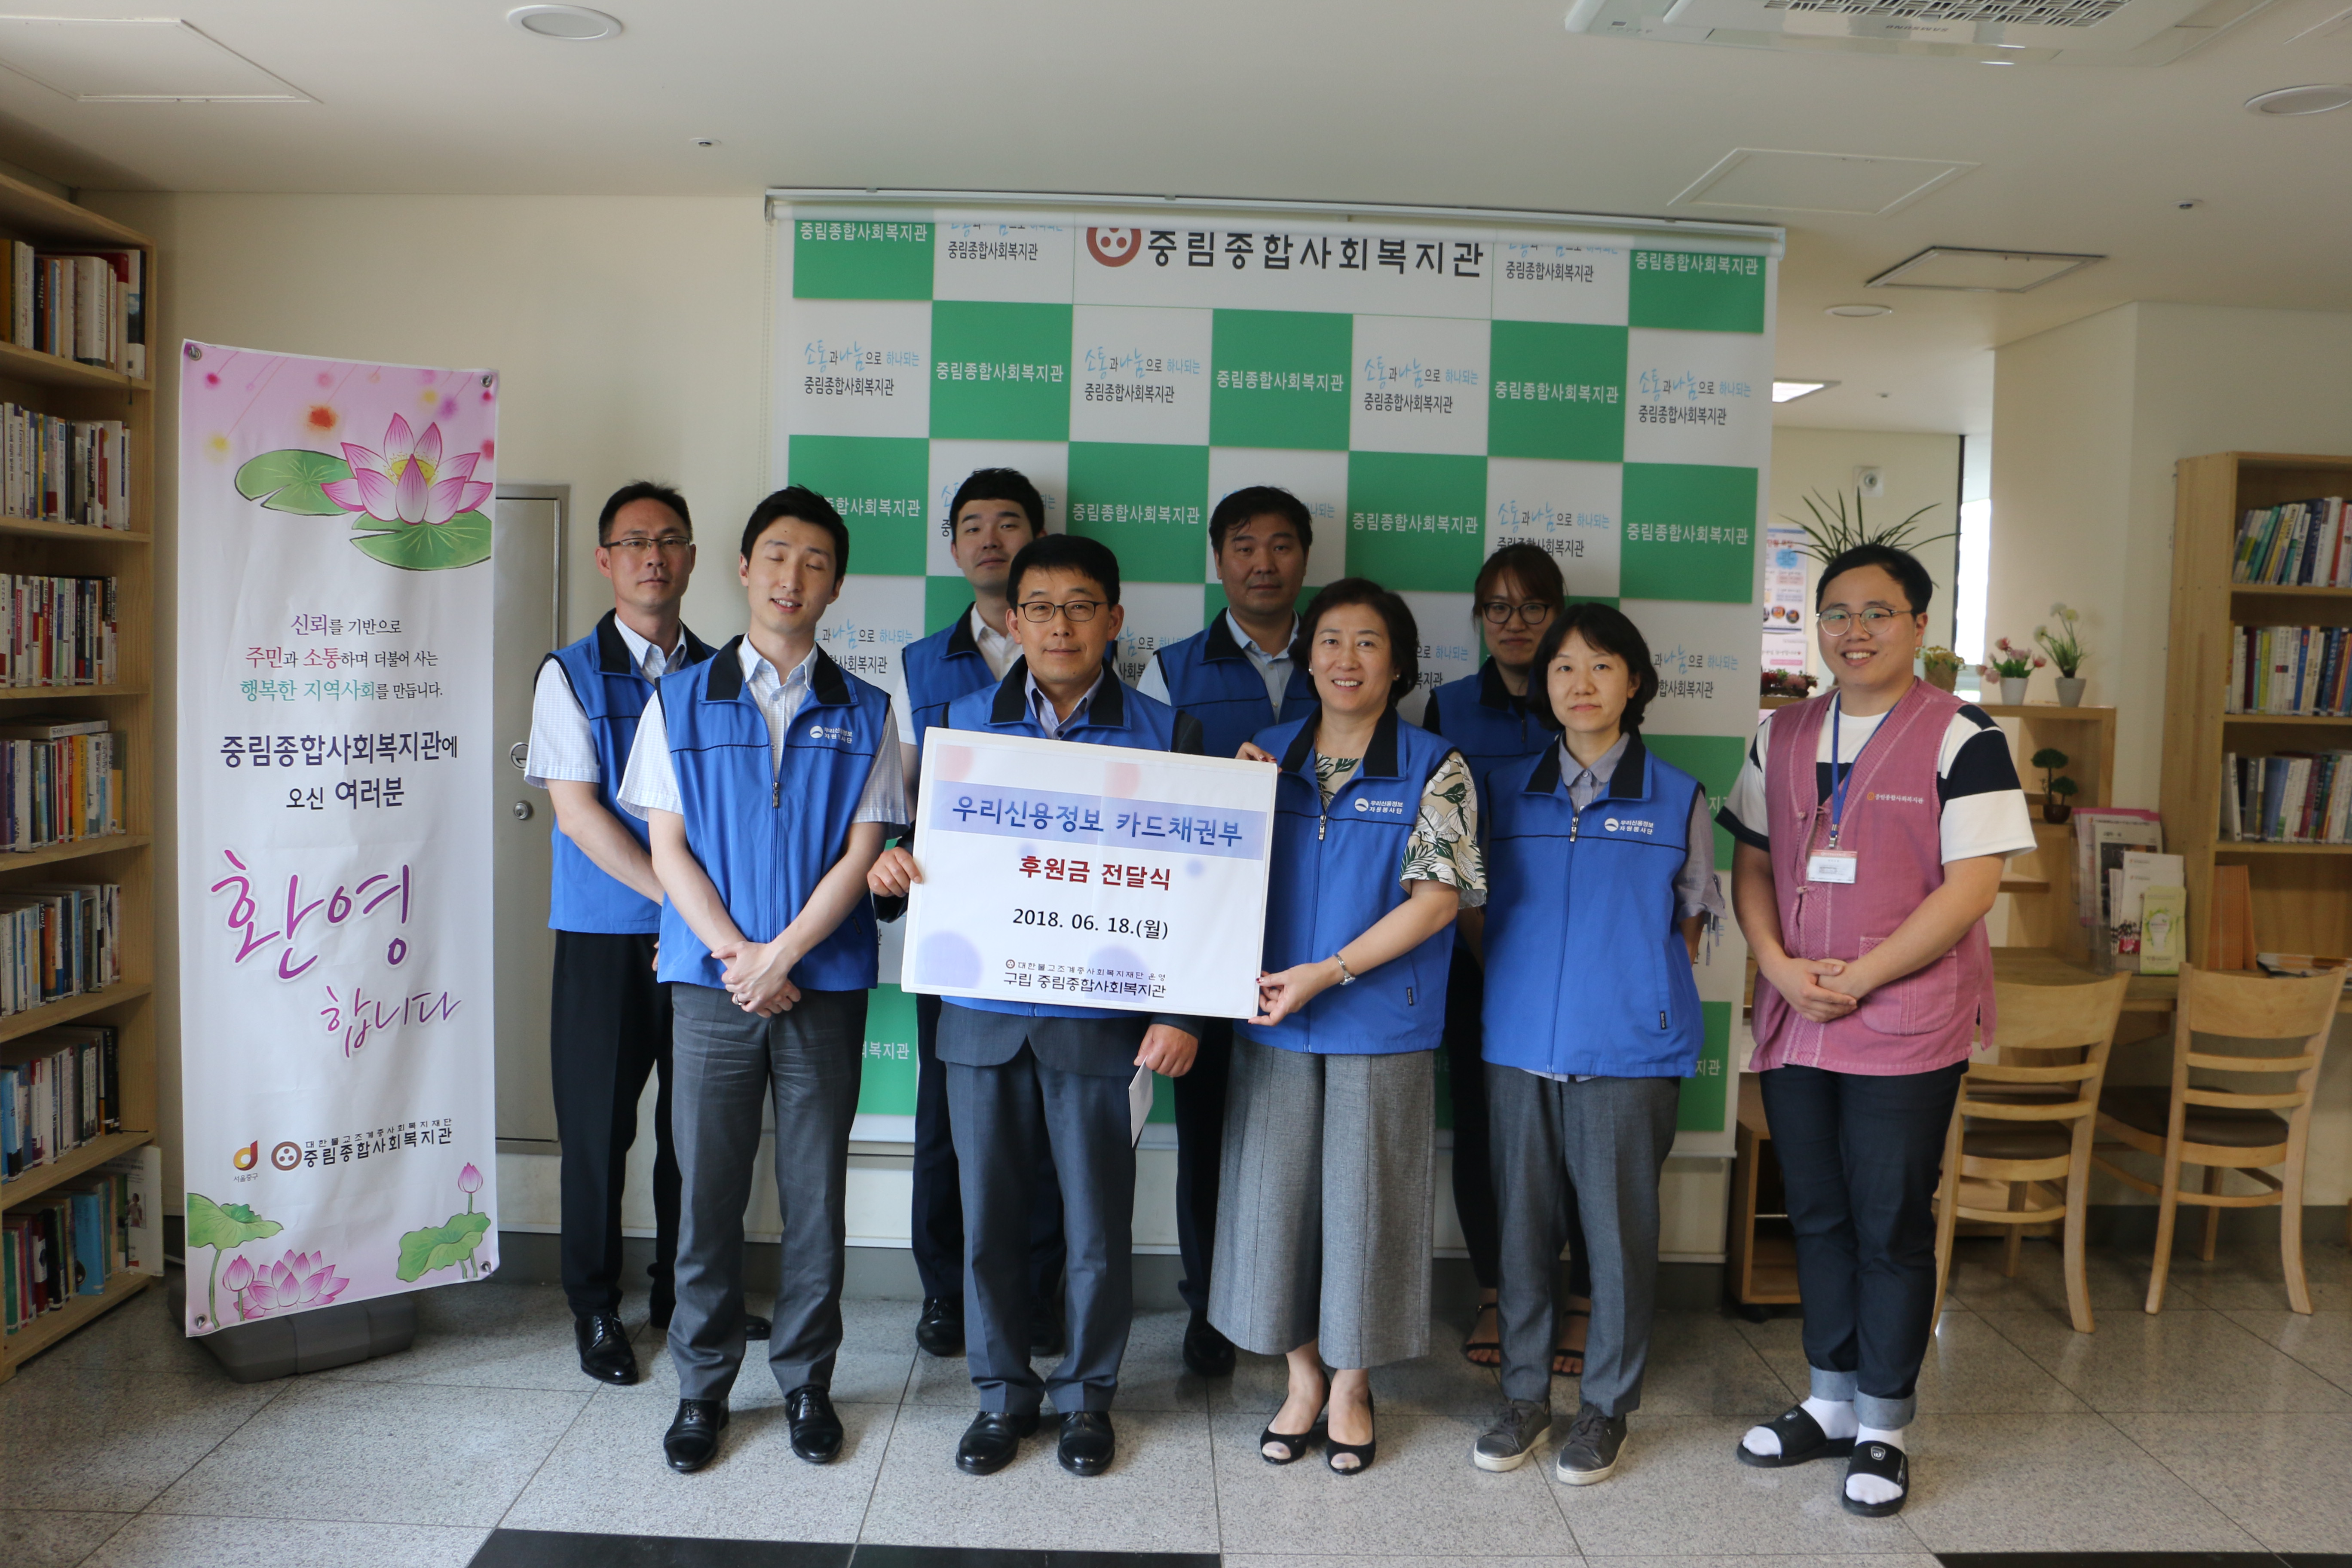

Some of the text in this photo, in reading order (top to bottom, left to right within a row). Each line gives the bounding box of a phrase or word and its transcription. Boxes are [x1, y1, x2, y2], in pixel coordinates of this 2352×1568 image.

[800, 222, 928, 242] 중림종합사회복지관
[948, 242, 1038, 260] 중림종합사회복지관
[1148, 230, 1483, 278] 중림종합사회복지관
[1506, 261, 1594, 282] 중림종합사회복지관
[1635, 252, 1758, 275] 중림종합사회복지관
[886, 352, 919, 367] 하나되는
[1167, 359, 1200, 375] 하나되는
[936, 362, 1063, 382] 중림종합사회복지관
[1216, 371, 1344, 392] 중림종합사회복지관
[1446, 369, 1478, 386] 하나되는
[804, 377, 894, 396] 중림종합사회복지관
[1085, 383, 1175, 404] 중림종합사회복지관
[1494, 381, 1618, 404] 중림종합사회복지관
[1719, 382, 1751, 398] 하나되는
[1364, 393, 1453, 414] 중림종합사회복지관
[1638, 406, 1727, 425] 중림종합사회복지관
[828, 497, 920, 517] 합사회복지관
[1072, 504, 1200, 524] 중림종합사회복지관
[1303, 502, 1335, 518] 나되는
[1352, 512, 1478, 534] 중림종합사회복지관
[1577, 513, 1609, 529] 하나되는
[1626, 523, 1749, 545] 중림종합사회복지관
[291, 613, 402, 637] 신뢰를 기반으로
[880, 629, 913, 644] 하나되는
[245, 646, 438, 670] 주민과 소통하며 더불어 사는
[1436, 645, 1468, 661] 하나되는
[1708, 655, 1738, 670] 하나되는
[830, 655, 887, 674] 사회복지관
[240, 679, 443, 701] 행복한 지역사회를 만듭니다.
[1659, 680, 1713, 698] 합사회복지관
[220, 730, 457, 769] 중림종합사회복지관에
[286, 777, 404, 810] 오신 여러분
[952, 796, 1243, 847] 우리신용정보 카드채권부
[1019, 855, 1171, 891] 후원금 전달식
[211, 849, 410, 980] 환영
[1012, 908, 1169, 940] 2018. 06. 18.(월)
[1018, 962, 1144, 980] 대한불교조계종사회복지재단
[1004, 972, 1166, 998] 구립 중림종합사회복지관
[321, 985, 462, 1058] 합니다
[305, 1118, 452, 1149] 대한불교조계종사회복지재단
[303, 1128, 452, 1167] 중림종합사회복지관
[233, 1173, 258, 1183] 서울중구
